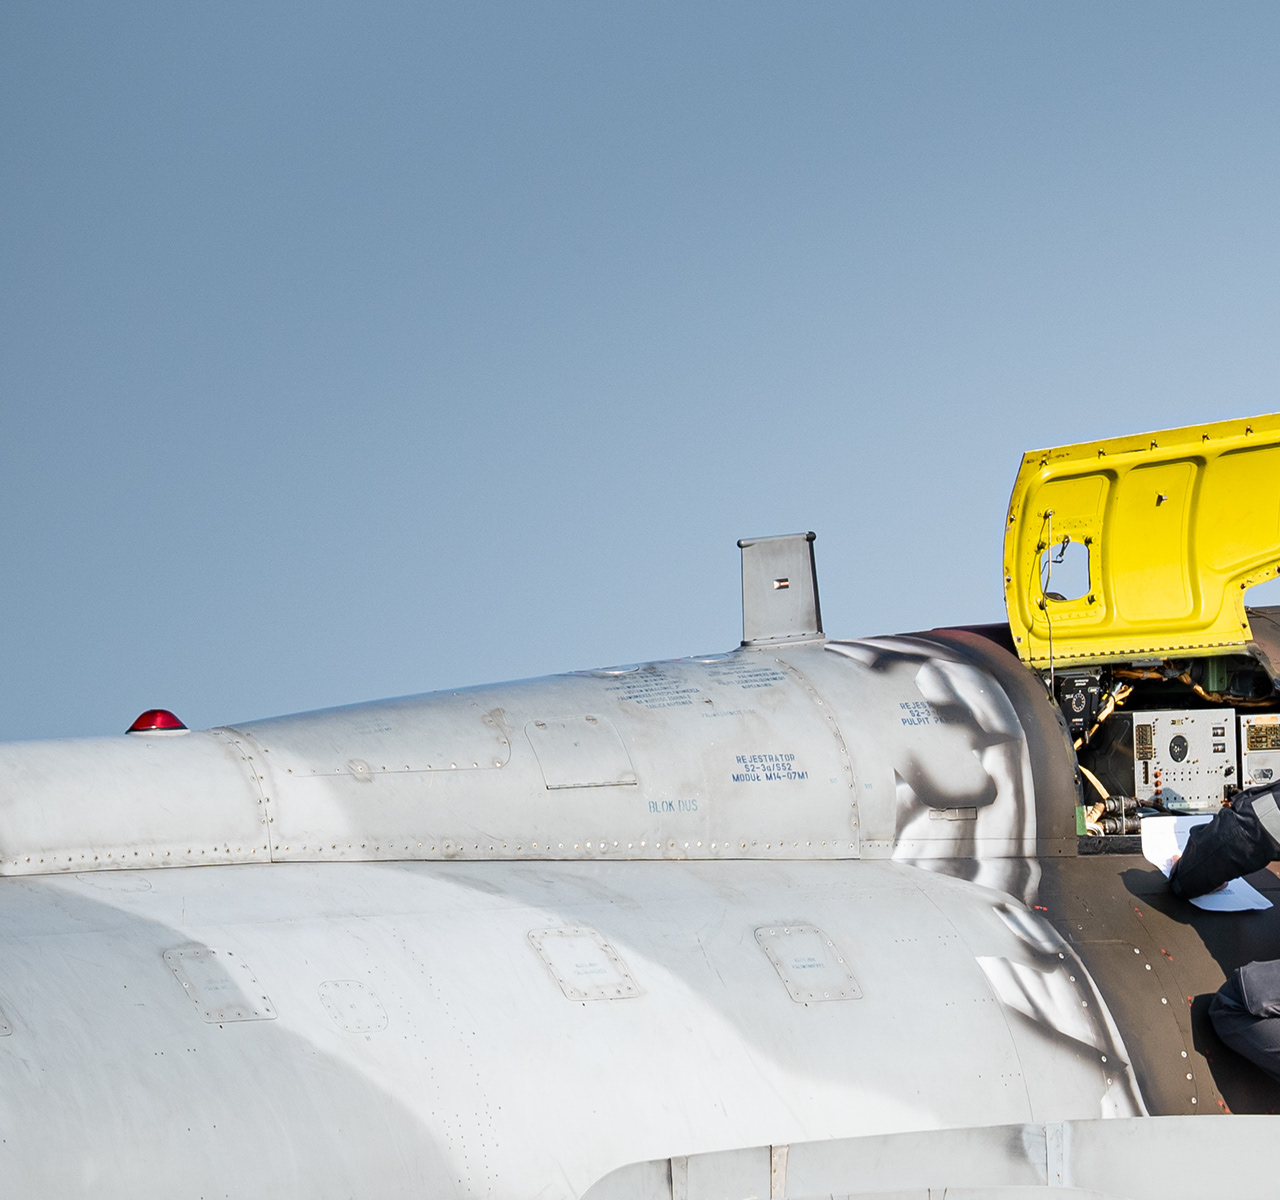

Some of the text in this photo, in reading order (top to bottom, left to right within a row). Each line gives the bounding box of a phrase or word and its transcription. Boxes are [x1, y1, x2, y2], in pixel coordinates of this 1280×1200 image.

[901, 717, 930, 726] PULPIT
[735, 753, 796, 764] REJESTRATOR
[649, 800, 676, 813] BLOK
